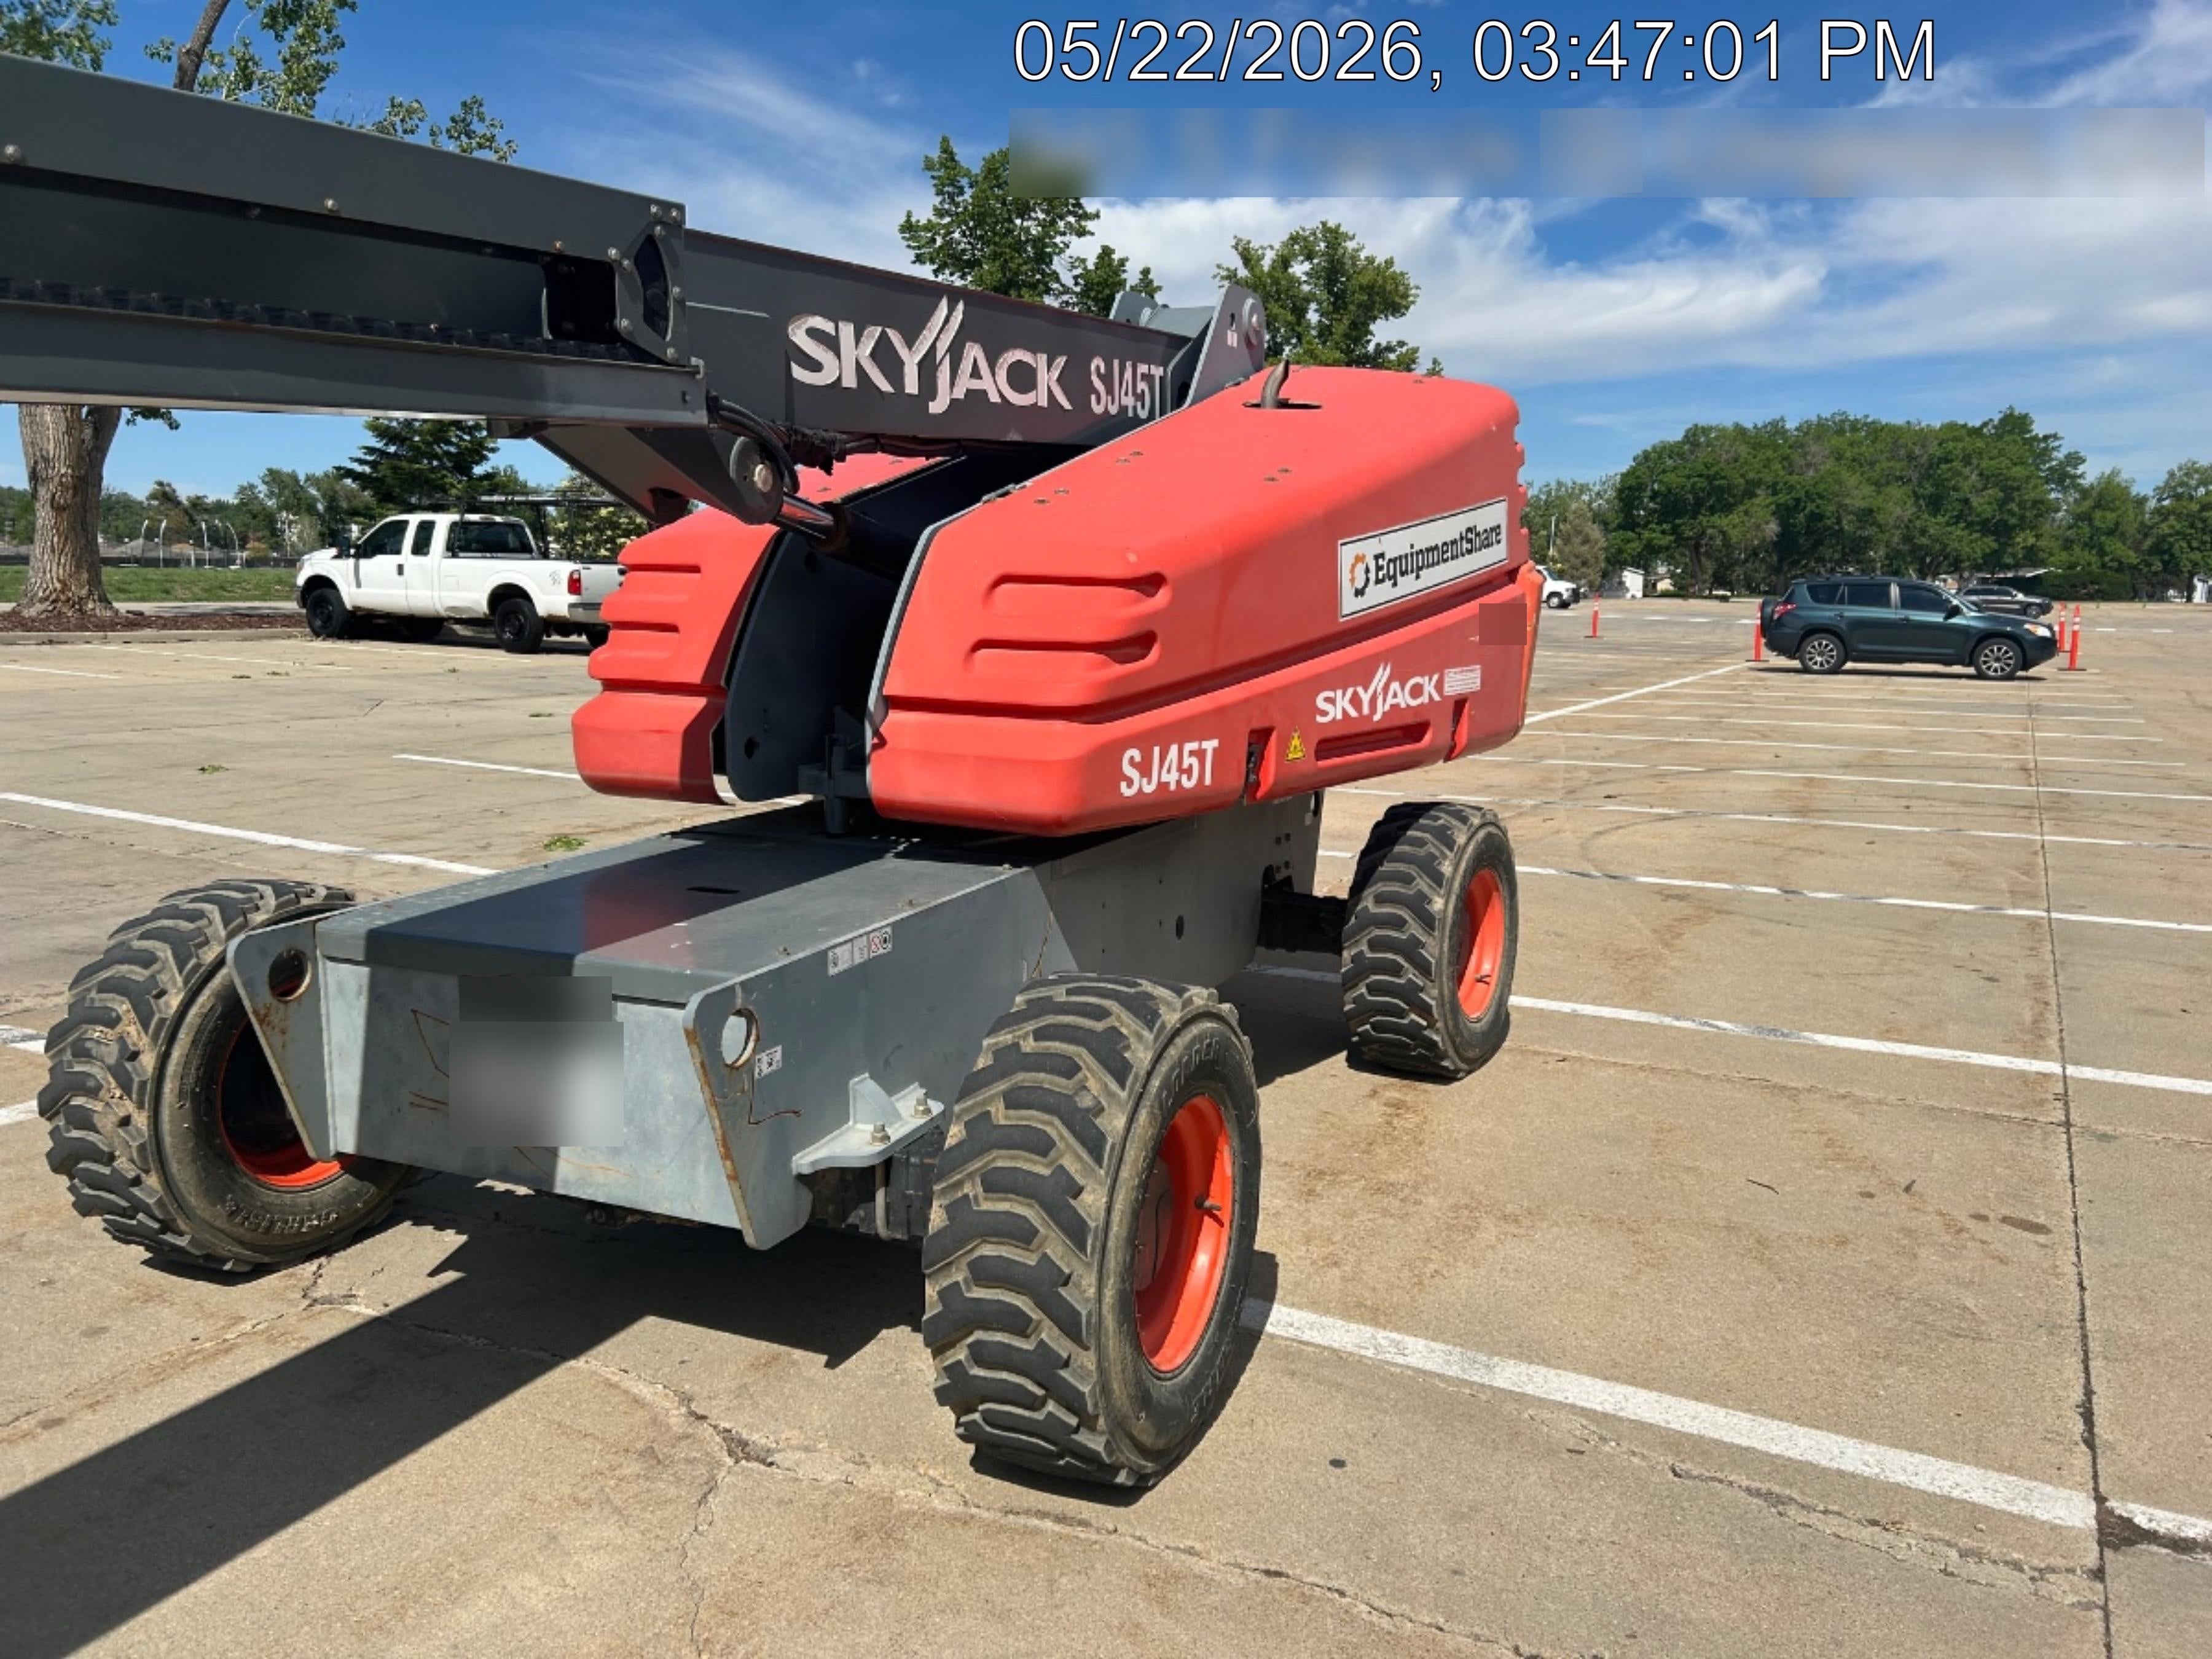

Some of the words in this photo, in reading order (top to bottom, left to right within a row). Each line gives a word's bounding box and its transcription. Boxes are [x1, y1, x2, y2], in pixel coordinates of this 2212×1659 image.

[788, 295, 1073, 414] SKYJACK
[1090, 356, 1164, 419] SJ45T
[1373, 523, 1502, 588] EquipmentShare
[1315, 664, 1441, 723] SKYJACK
[1120, 739, 1218, 797] SJ45T
